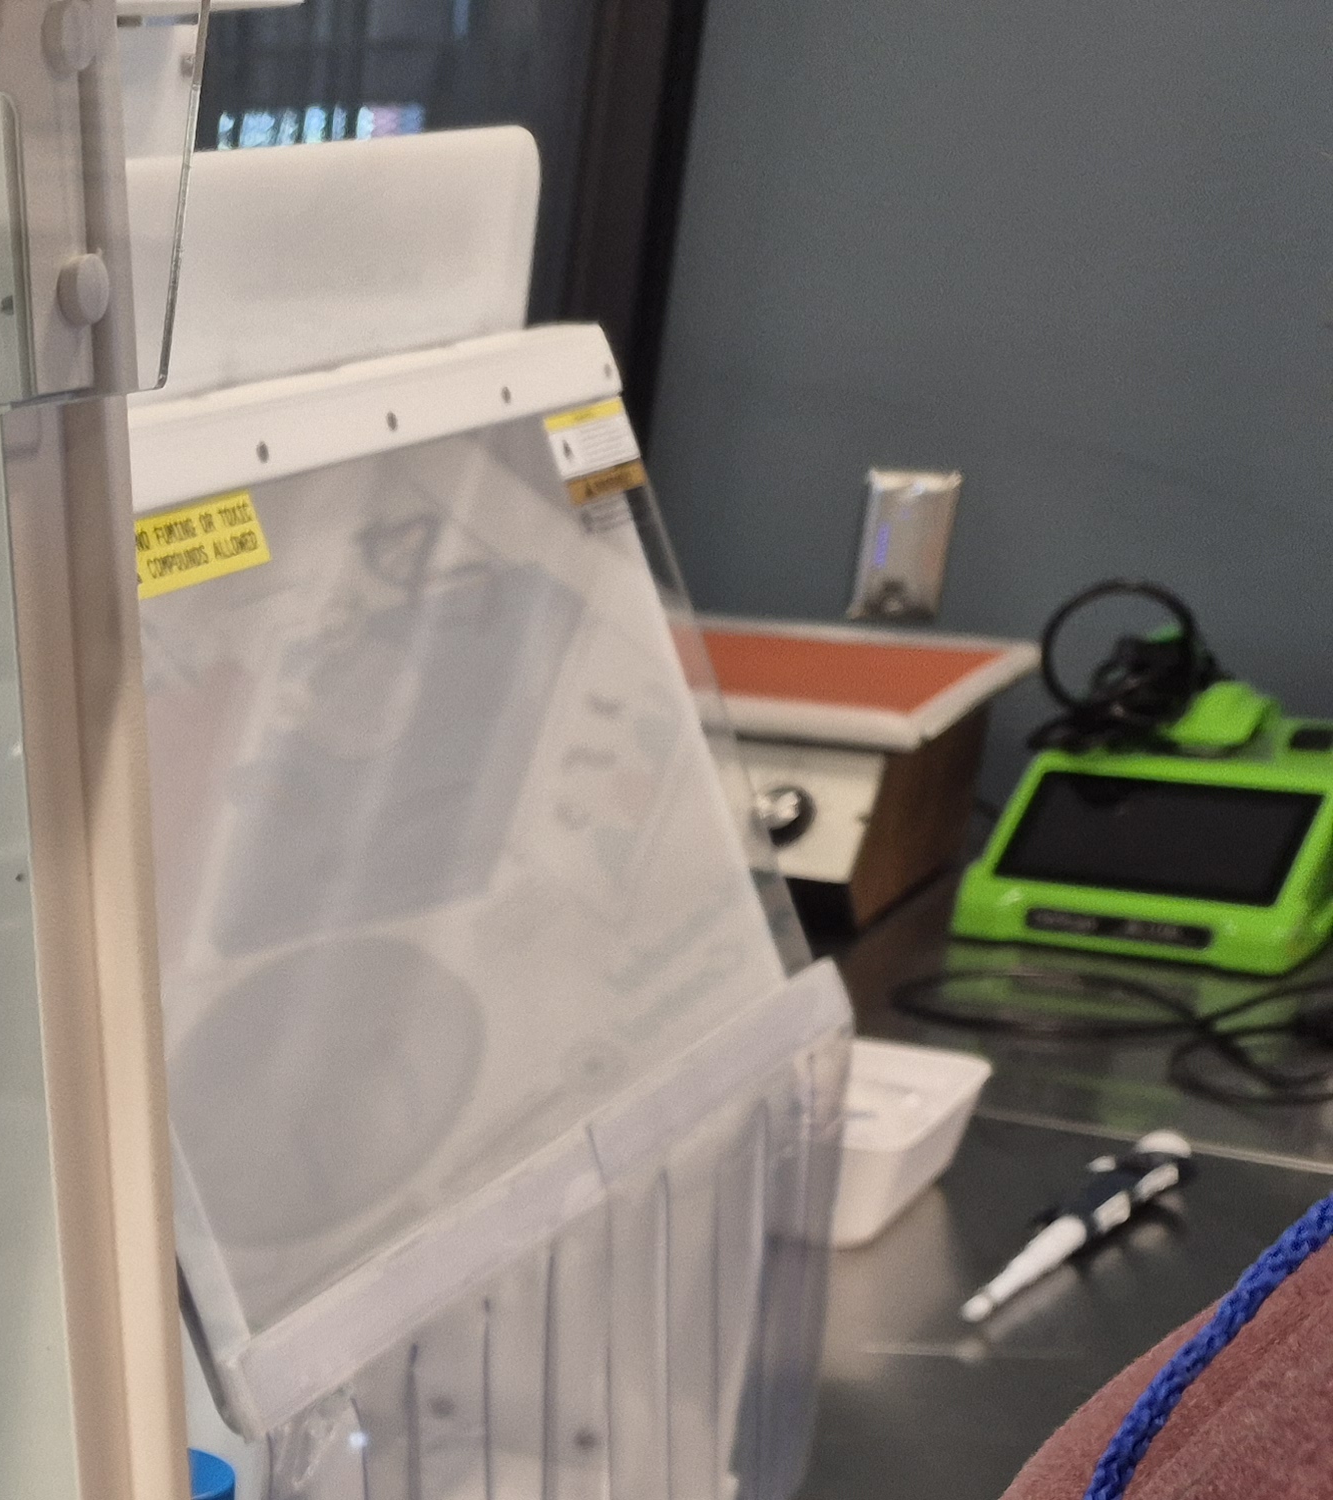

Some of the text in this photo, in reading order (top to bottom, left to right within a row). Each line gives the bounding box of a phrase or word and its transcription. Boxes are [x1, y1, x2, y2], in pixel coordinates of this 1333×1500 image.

[154, 518, 196, 544] FUMING
[200, 512, 216, 533] OR
[147, 529, 258, 578] COMPOUNDS ALLOWED
